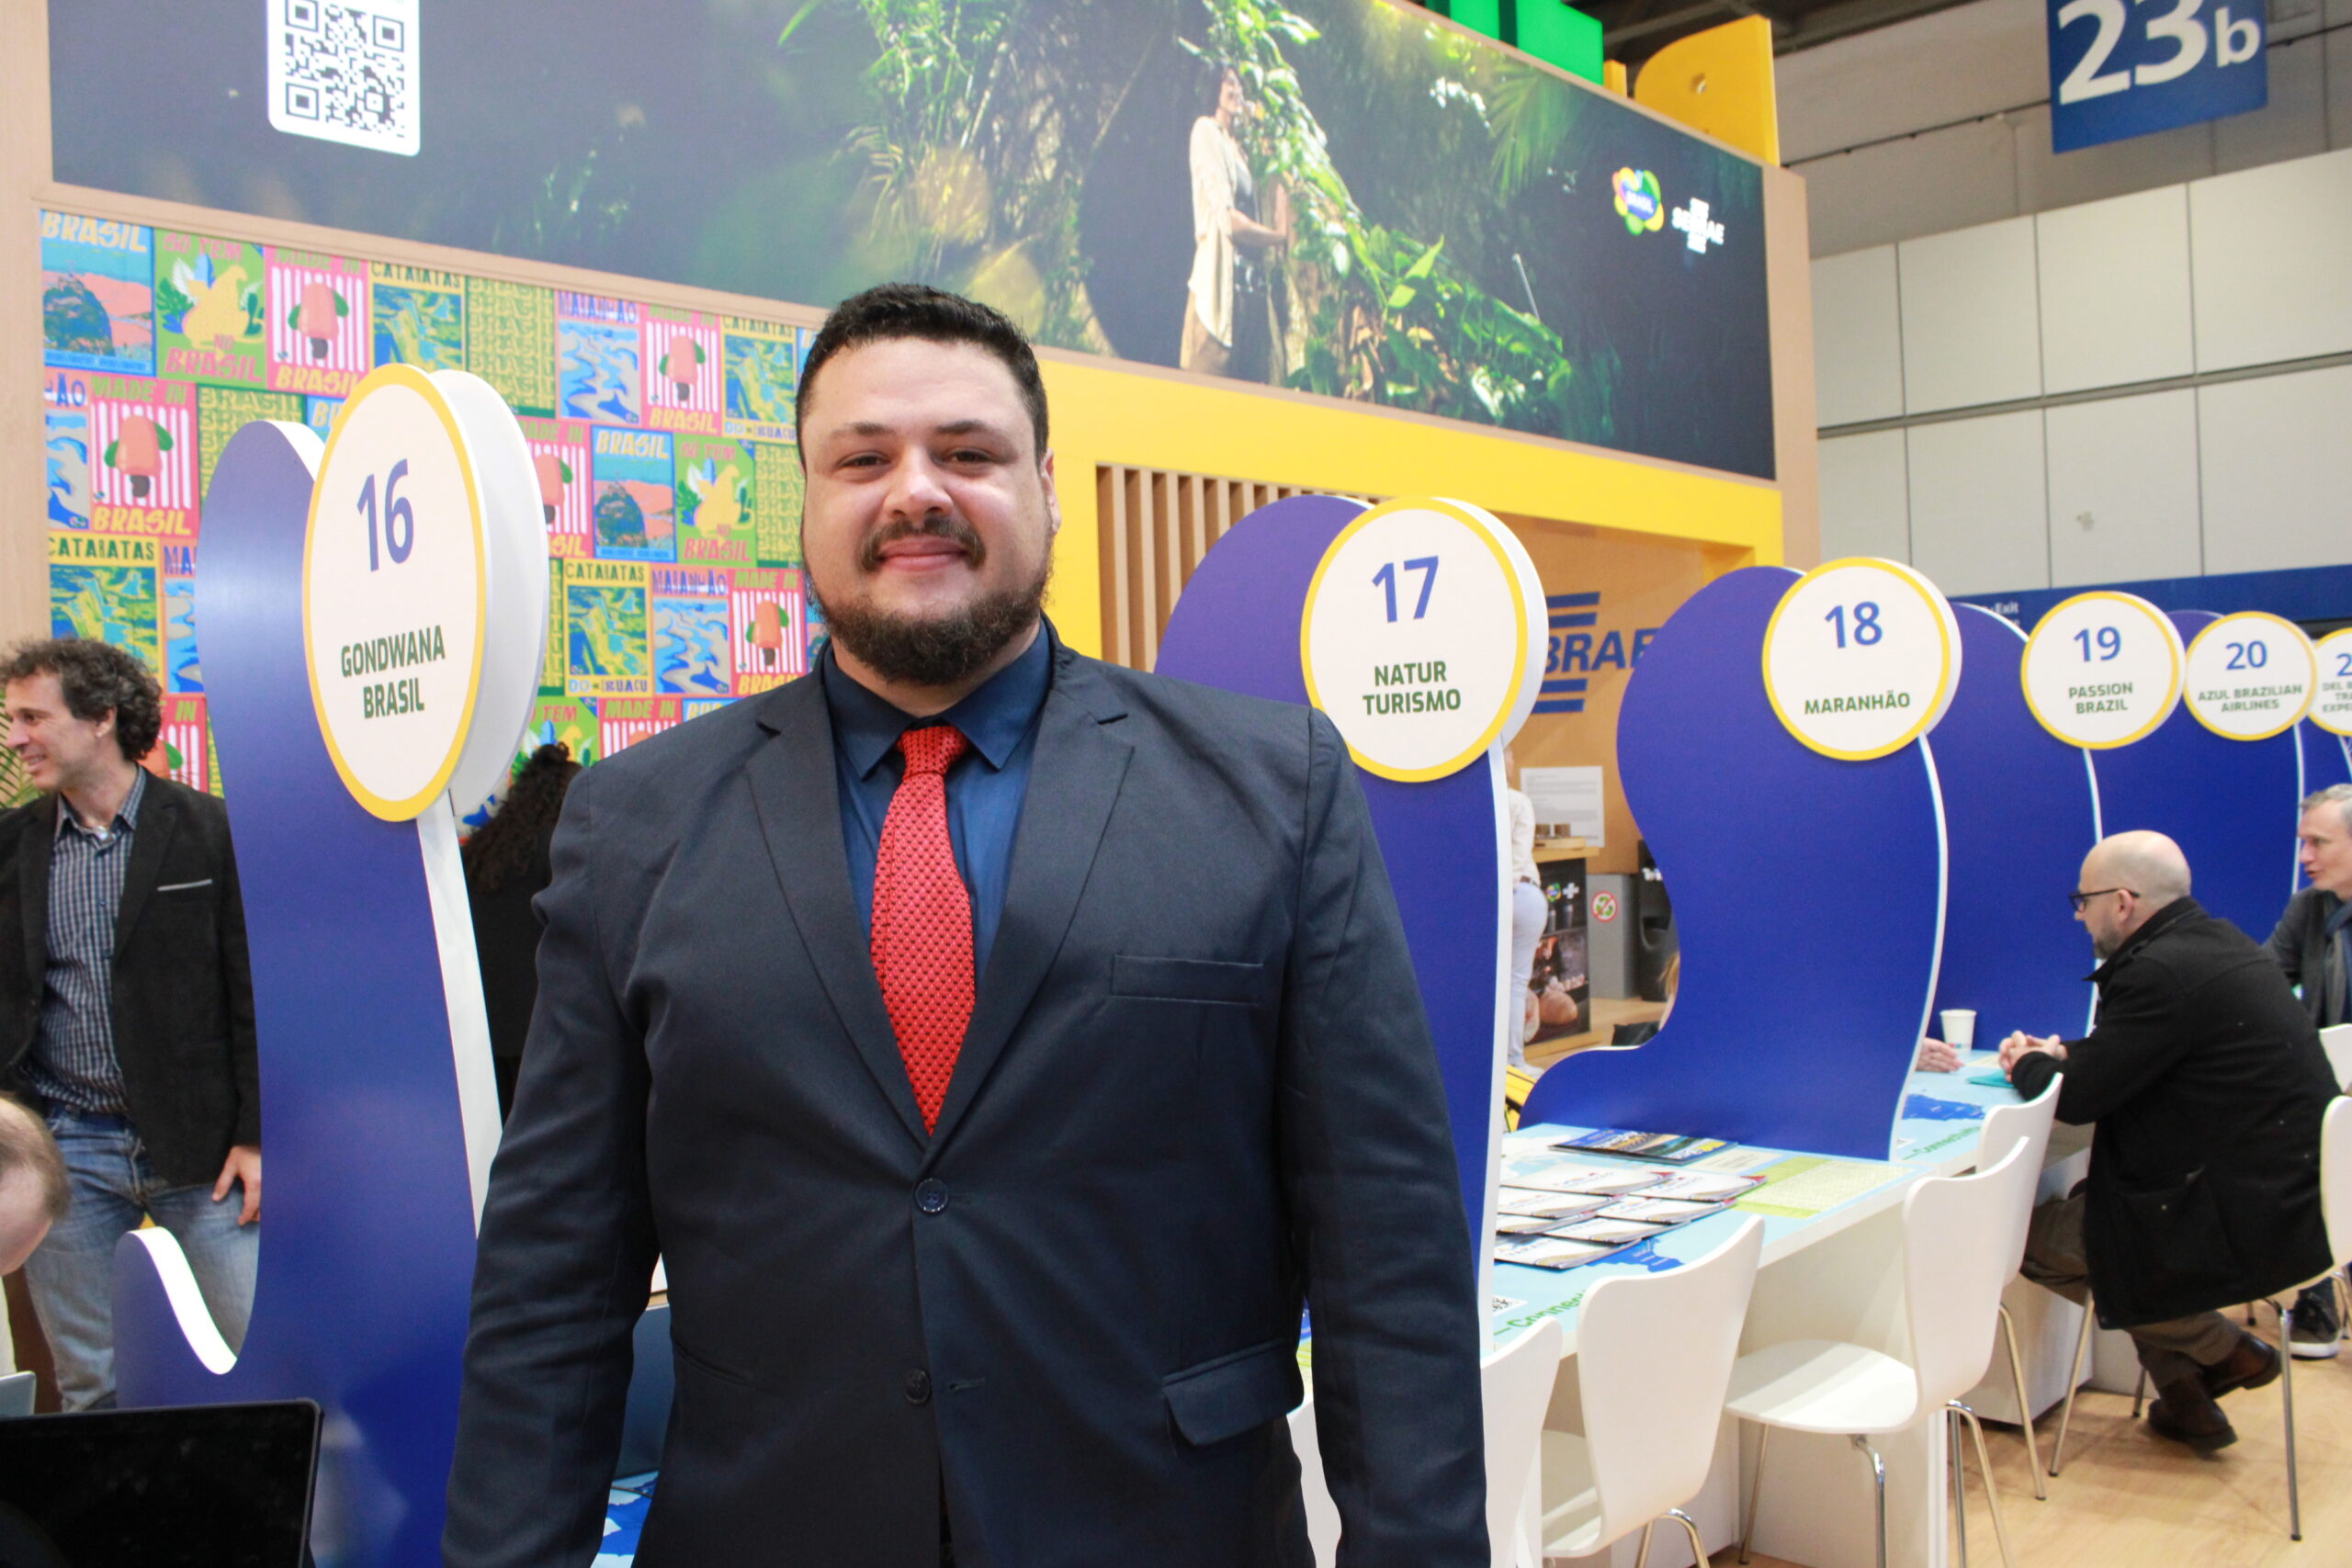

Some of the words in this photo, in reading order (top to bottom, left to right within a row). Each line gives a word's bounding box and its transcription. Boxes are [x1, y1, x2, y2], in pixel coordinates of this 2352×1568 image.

[2058, 0, 2261, 105] 23b
[41, 211, 147, 253] BRASIL
[164, 347, 263, 382] BRASIL
[93, 377, 157, 402] MADE
[164, 383, 187, 405] IN
[568, 424, 583, 444] IN
[650, 407, 718, 434] BRASIL
[596, 431, 670, 459] BRASIL
[705, 444, 736, 461] TEM
[94, 506, 192, 536] BRASIL
[356, 458, 413, 573] 16
[684, 538, 752, 562] BRASIL
[734, 570, 778, 589] MADE
[784, 571, 797, 589] IN
[1372, 556, 1439, 624] 17
[1824, 601, 1883, 649] 18
[341, 625, 446, 678] GONDWANA
[2074, 626, 2121, 662] 19
[2225, 640, 2267, 671] 20
[569, 679, 592, 693] DO
[738, 674, 799, 695] BRAS
[1374, 660, 1447, 687] NATUR
[363, 677, 424, 719] BRASIL
[1363, 689, 1461, 716] TURISMO
[1804, 690, 1911, 715] MARANHÃO
[2068, 682, 2133, 698] PASSION
[2198, 690, 2230, 701] AZUL
[2233, 684, 2302, 699] BRAZILIAN
[175, 700, 197, 722] IN
[543, 705, 578, 723] TEM
[605, 700, 653, 719] MADE
[660, 700, 675, 719] IN
[2075, 699, 2128, 715] BRAZIL
[2221, 699, 2279, 713] AIRLINES
